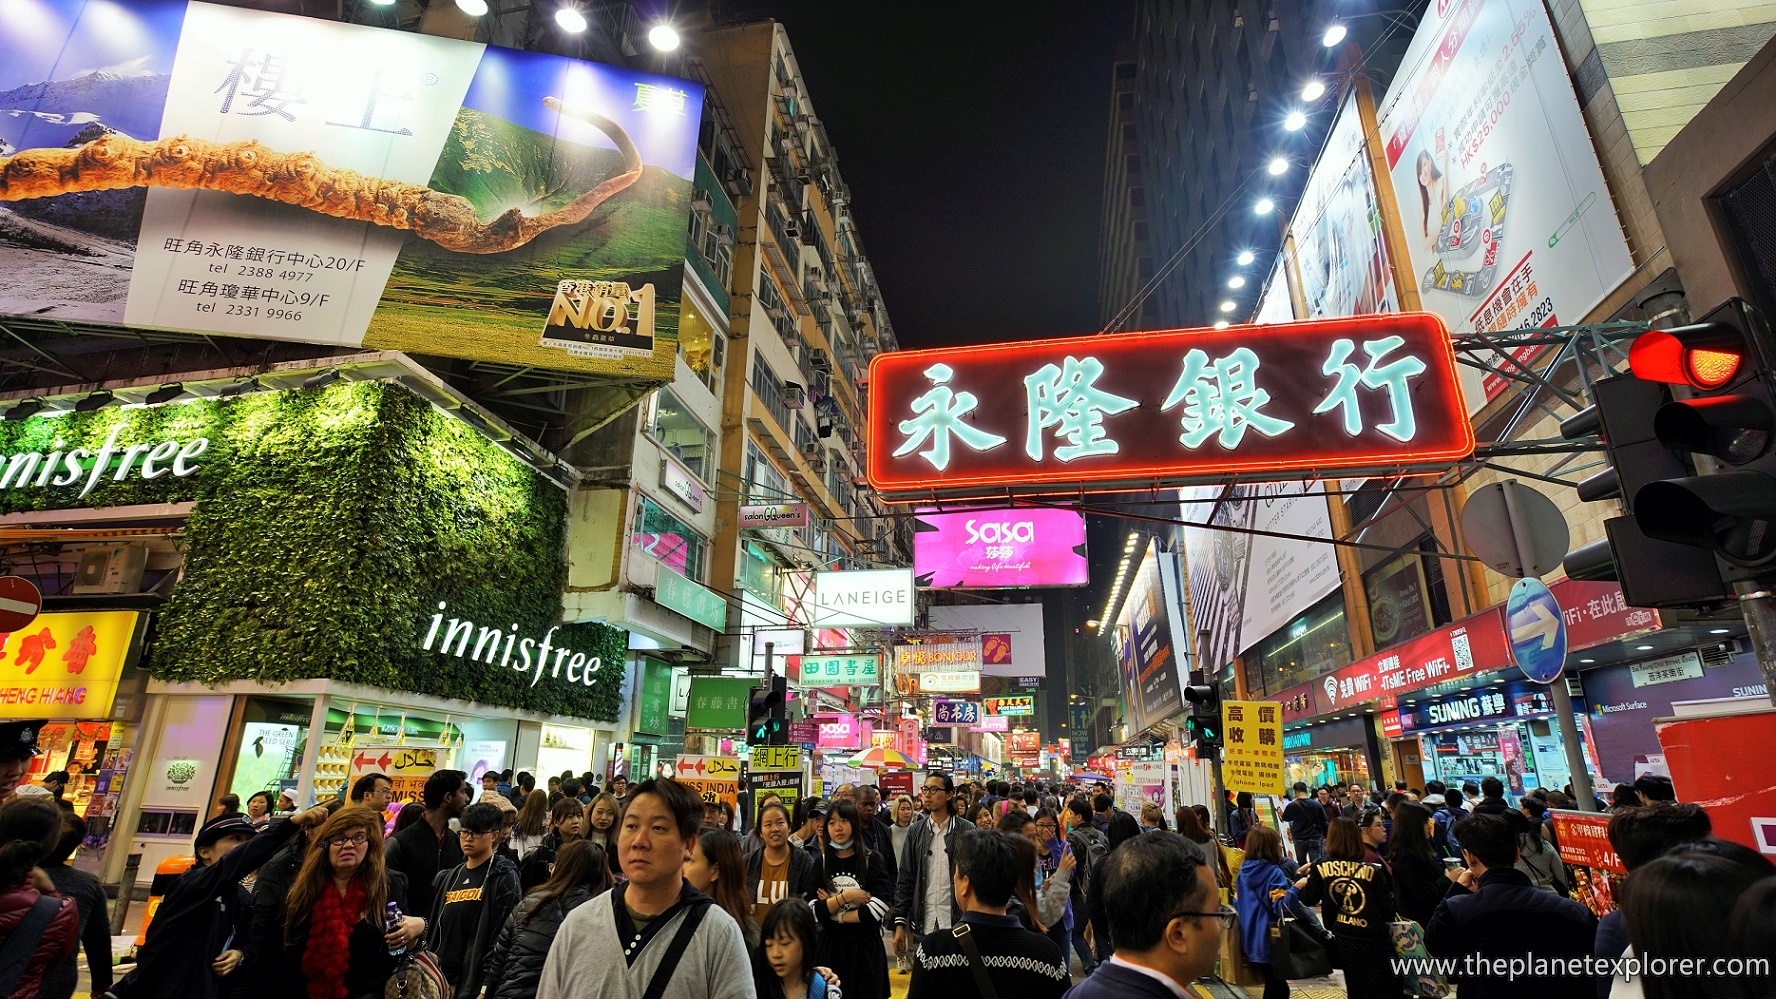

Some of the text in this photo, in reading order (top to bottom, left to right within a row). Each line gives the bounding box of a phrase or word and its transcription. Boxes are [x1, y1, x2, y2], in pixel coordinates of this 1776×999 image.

[1502, 4, 1537, 61] 2.55%
[214, 48, 413, 136] 樓上
[1461, 91, 1510, 170] HK$25,000
[208, 263, 314, 283] tel 2388 4977
[196, 302, 302, 322] tel 2331 9966
[892, 335, 1427, 471] 永隆銀行
[744, 510, 764, 521] salon
[822, 589, 906, 606] LANEIGE
[423, 601, 601, 687] innisfree
[928, 651, 977, 664] BONJOUR
[804, 659, 877, 676] 田園書屋
[1354, 673, 1372, 693] WiFi
[1406, 668, 1425, 685] Free
[39, 687, 87, 705] HIANG
[1732, 684, 1768, 697] SUNIN
[1228, 706, 1275, 723] 高價
[1428, 697, 1480, 724] SUNING
[1602, 701, 1647, 713] Microsoft Surface
[259, 729, 294, 739] THE GREEN
[1229, 727, 1276, 745] 收購
[395, 753, 436, 769] حلال
[753, 747, 799, 768] 網上行
[708, 760, 737, 774] حلال
[706, 782, 736, 794] INDIA
[1260, 780, 1274, 788] Ipad
[391, 790, 425, 802] MISS
[1316, 861, 1375, 882] MOSCHINO
